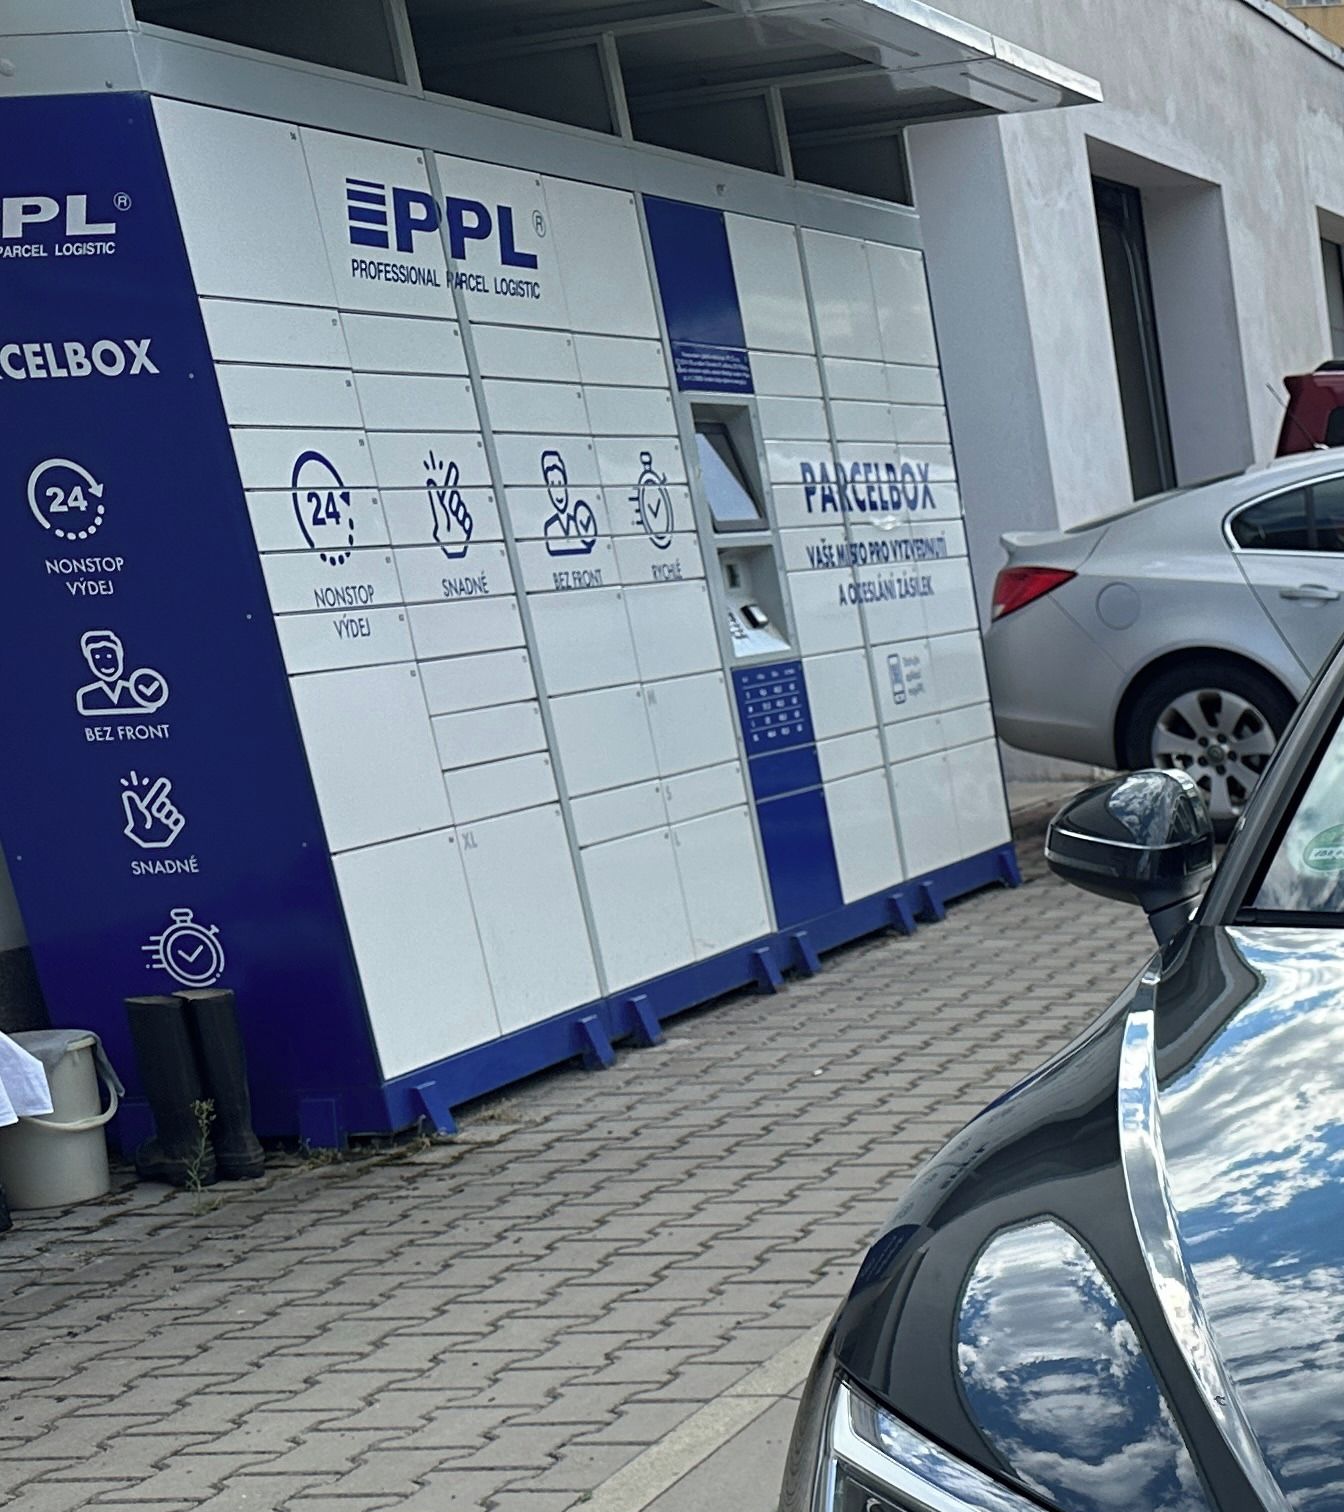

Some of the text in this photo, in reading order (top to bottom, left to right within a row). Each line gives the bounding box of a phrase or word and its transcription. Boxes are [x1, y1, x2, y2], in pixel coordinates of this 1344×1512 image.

[392, 186, 539, 270] PPL
[55, 241, 116, 256] LOGISTIC
[351, 258, 541, 300] PROFESSIONAL PARCEL LOGISTIC
[0, 338, 160, 380] CELBOX
[45, 486, 88, 513] 24
[800, 461, 937, 514] PARCELBOX
[306, 491, 341, 526] 24
[45, 557, 124, 575] NONSTOP
[806, 537, 836, 569] VAŠE
[868, 540, 889, 565] PRO
[552, 568, 604, 591] BEZ FRONT
[651, 558, 683, 581] RYCHLÉ
[66, 577, 114, 596] VÝDEJ
[314, 583, 375, 608] NONSTOP
[441, 570, 490, 598] SNADNÉ
[838, 583, 849, 606] A
[333, 613, 371, 640] VÝDEJ
[84, 724, 170, 742] BEZ FRONT
[130, 855, 200, 875] SNADNÉ
